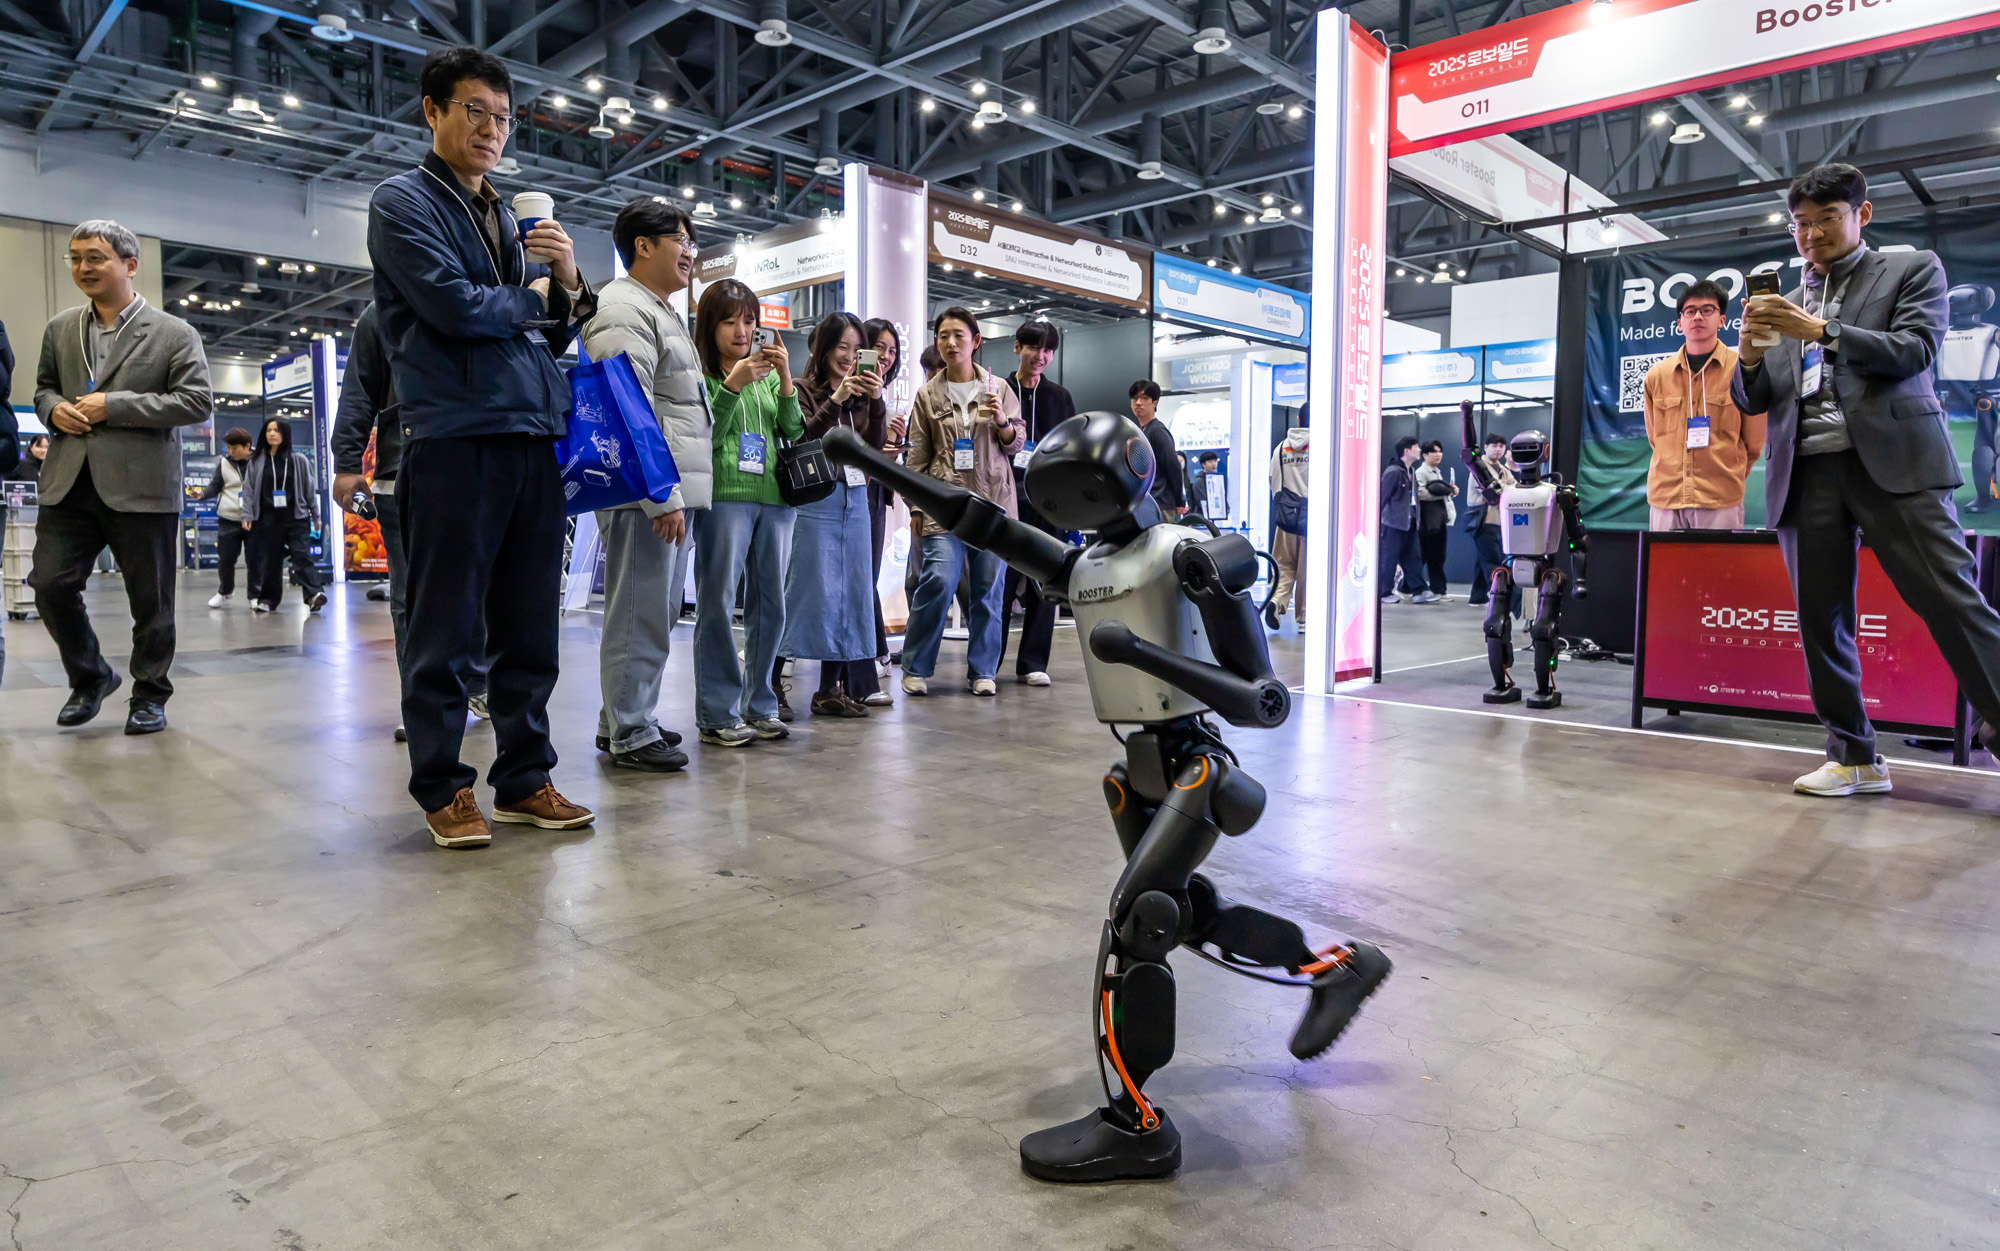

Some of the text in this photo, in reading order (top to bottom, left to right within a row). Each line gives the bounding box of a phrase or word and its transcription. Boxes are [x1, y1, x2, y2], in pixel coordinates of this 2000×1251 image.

[960, 243, 978, 257] D32
[1021, 247, 1050, 261] Interactive
[1050, 254, 1054, 262] &
[1055, 256, 1082, 269] Networked
[1083, 262, 1103, 274] Robotics
[1104, 267, 1130, 281] Laboratory
[1005, 254, 1129, 292] SNU Interactive & Networked Robotics Laboratory
[766, 308, 786, 319] 소화기
[1620, 324, 1665, 342] Made
[1283, 457, 1295, 465] EAN
[1078, 585, 1114, 600] BOOSTER
[1709, 636, 1875, 654] ROBOTWD
